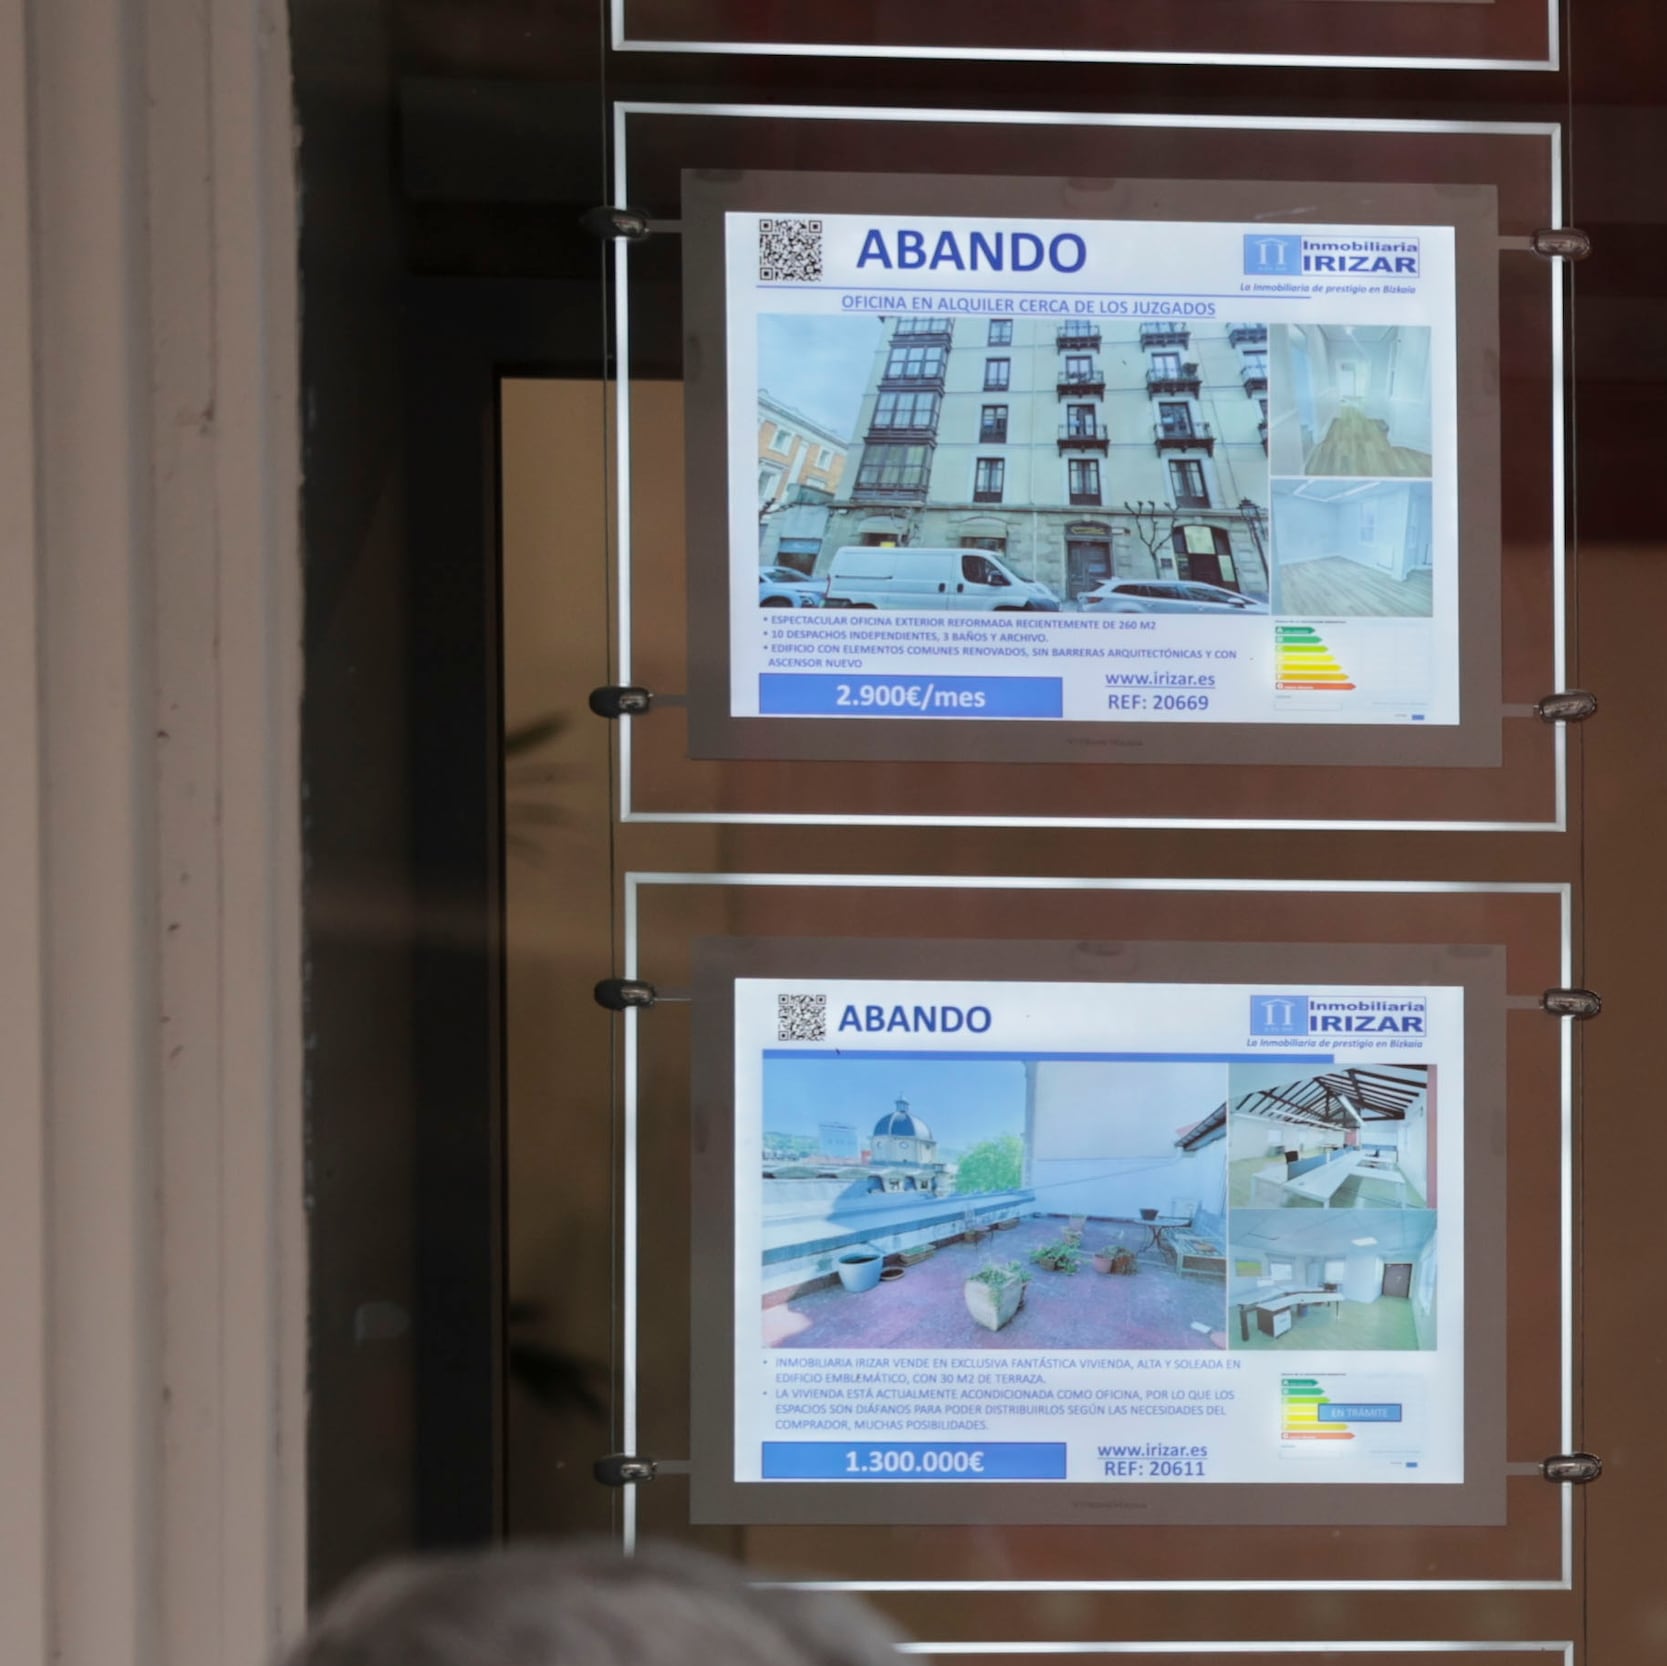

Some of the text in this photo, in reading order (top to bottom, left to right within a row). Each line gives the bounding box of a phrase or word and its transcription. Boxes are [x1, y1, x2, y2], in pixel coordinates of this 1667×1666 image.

[855, 228, 1087, 274] ABANDO
[1303, 239, 1418, 253] Inmobiliaria
[1302, 254, 1417, 273] IRIZAR
[841, 295, 1216, 316] OFICINA EN ALQUILER CERCA DE LOS JUZGADOS
[1104, 669, 1215, 688] www.irizar.es
[835, 682, 986, 711] 2.900€/mes
[1107, 693, 1209, 711] REF: 20669
[1309, 1000, 1425, 1012] Inmobiliaria
[837, 1004, 992, 1033] ABANDO
[1309, 1014, 1423, 1033] IRIZAR
[1096, 1441, 1207, 1461] www.irizar.es
[845, 1450, 985, 1473] 1.300.000€
[1104, 1460, 1205, 1476] REF: 20611
